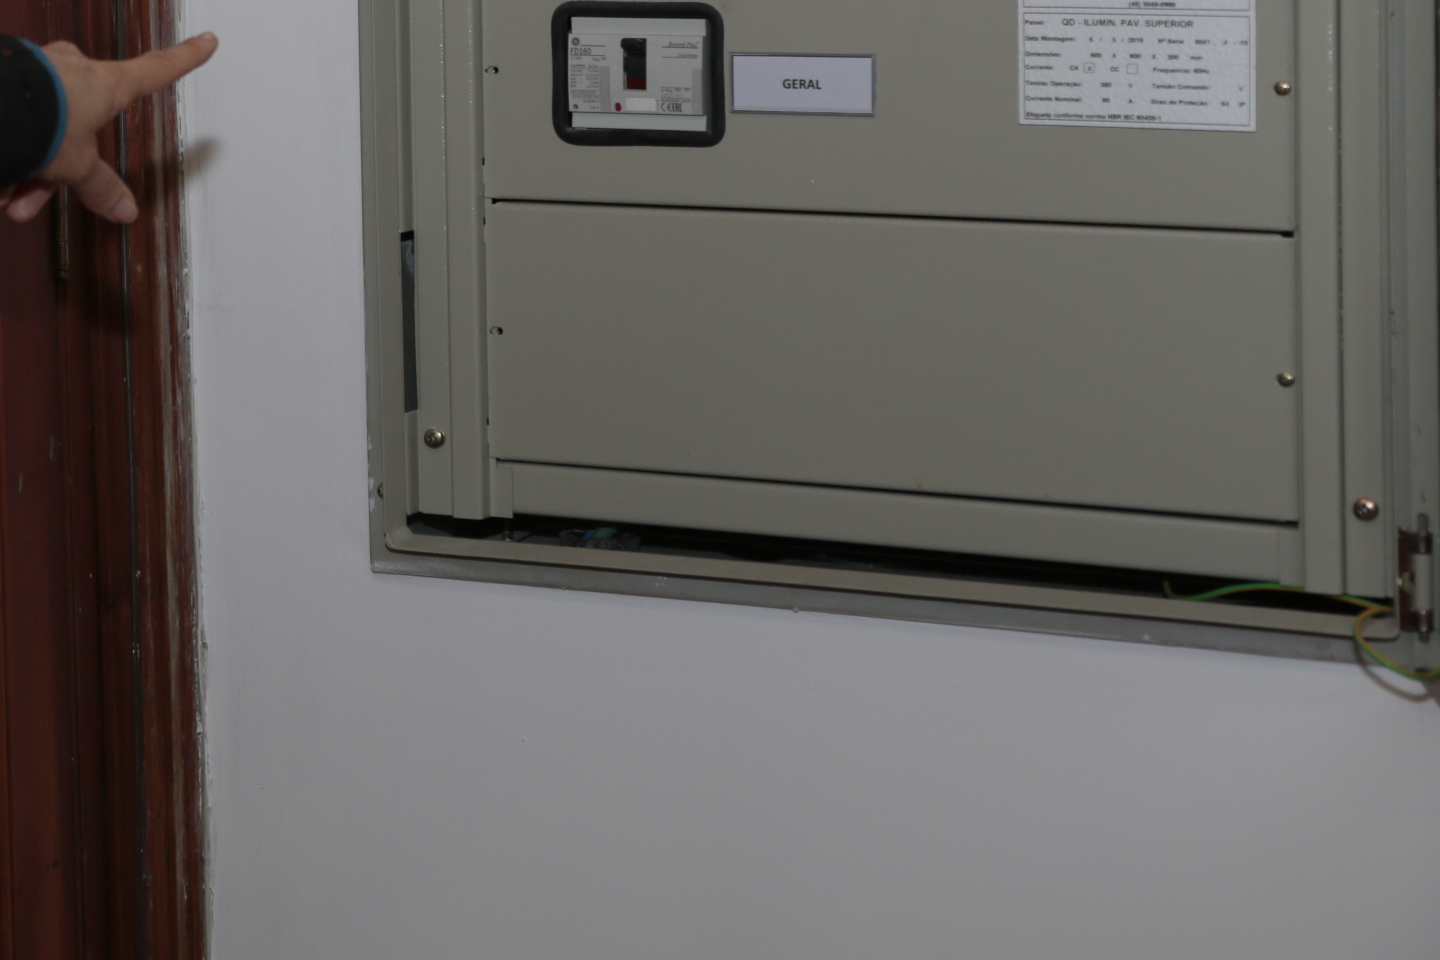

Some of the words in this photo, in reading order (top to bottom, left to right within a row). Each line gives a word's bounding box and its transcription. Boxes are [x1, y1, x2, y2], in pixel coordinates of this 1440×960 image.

[1062, 18, 1076, 27] QD
[1083, 19, 1118, 27] ILUMIN.
[1120, 19, 1142, 27] PAV.
[1145, 20, 1194, 28] SUPERIOR
[570, 47, 591, 56] FD160
[782, 78, 822, 90] GERAL
